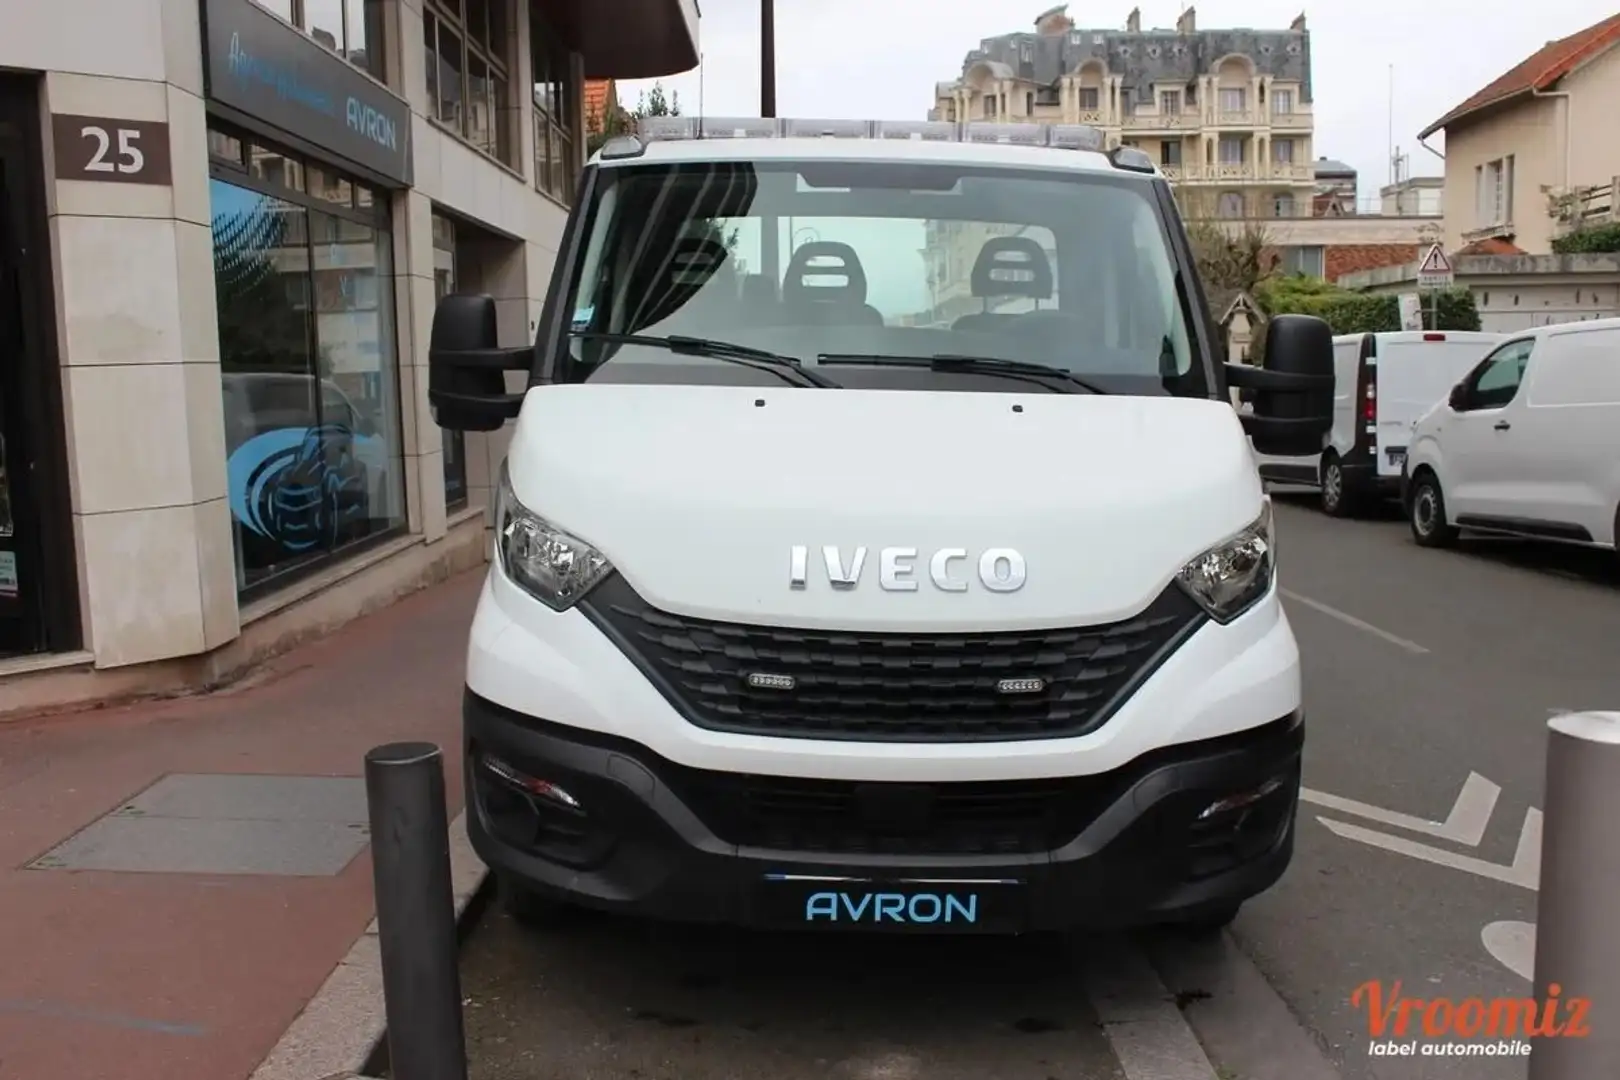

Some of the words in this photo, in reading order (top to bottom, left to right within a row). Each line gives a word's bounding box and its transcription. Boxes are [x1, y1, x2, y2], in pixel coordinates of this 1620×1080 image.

[346, 96, 397, 151] AVRON
[81, 126, 144, 174] 25
[790, 545, 1027, 592] IVECO
[806, 892, 977, 923] AVRON
